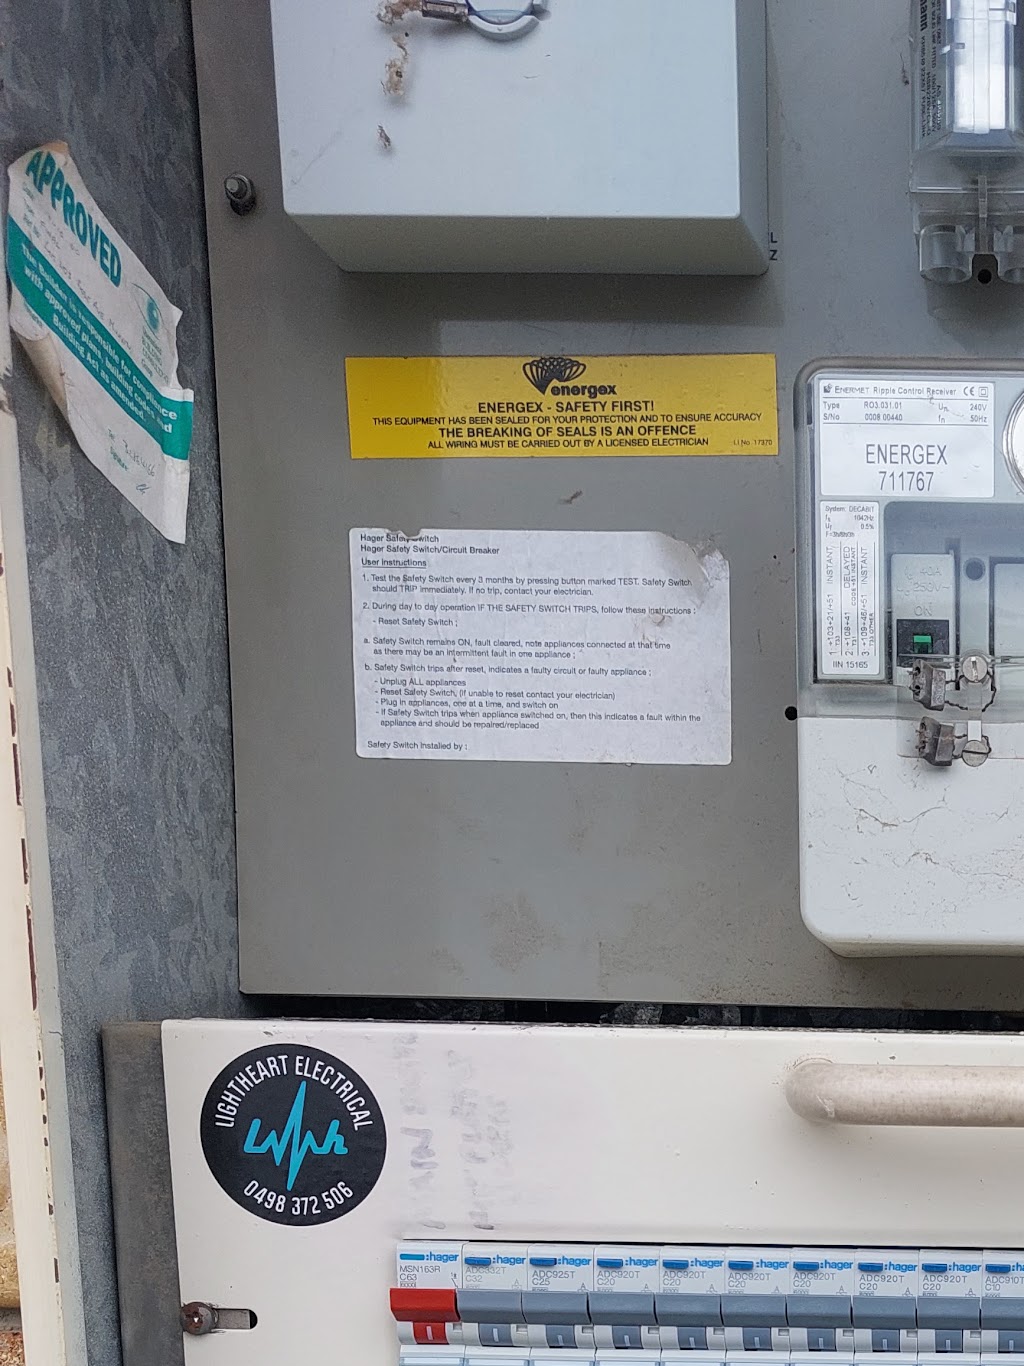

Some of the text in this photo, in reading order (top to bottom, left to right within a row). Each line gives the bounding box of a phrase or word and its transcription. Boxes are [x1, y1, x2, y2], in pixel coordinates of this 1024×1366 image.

[25, 151, 122, 288] APPROVED
[551, 384, 617, 399] energex
[834, 386, 957, 395] ENERMET Ripple Control Receiver
[478, 402, 543, 414] ENERGEX
[555, 401, 607, 413] SAFETY
[612, 400, 654, 412] FIRST!
[823, 402, 840, 410] Type
[970, 404, 987, 412] 240V
[373, 413, 762, 426] THIS EQUIPMENT HAS BEEN SEALED FOR YOUR PROTECTION AND TO ENSURE ACCURACY
[823, 413, 840, 421] S/No
[970, 415, 987, 423] 50Hz
[439, 425, 696, 438] THE BREAKING OF SEALS IS AN OFFENCE
[428, 438, 709, 449] ALL WIRING MUST BE CARRIED OUT BY A LICENSED ELECTRICIAN
[866, 444, 947, 465] ENERGEX
[878, 471, 934, 491] 711767
[360, 544, 500, 555] Hager Safety Switch/Circuit Breaker
[361, 558, 427, 567] User Instructions
[826, 546, 834, 584] INSTANT
[846, 661, 869, 669] 15165
[380, 677, 467, 688] Unplug ALL appliances
[367, 741, 391, 750] Safety
[392, 741, 419, 749] Switch
[453, 742, 463, 751] by
[215, 1055, 288, 1128] LIGHTHEART
[295, 1055, 373, 1131] ELECTRICAL
[244, 1180, 353, 1216] 0498 372 506
[399, 1273, 417, 1282] C63
